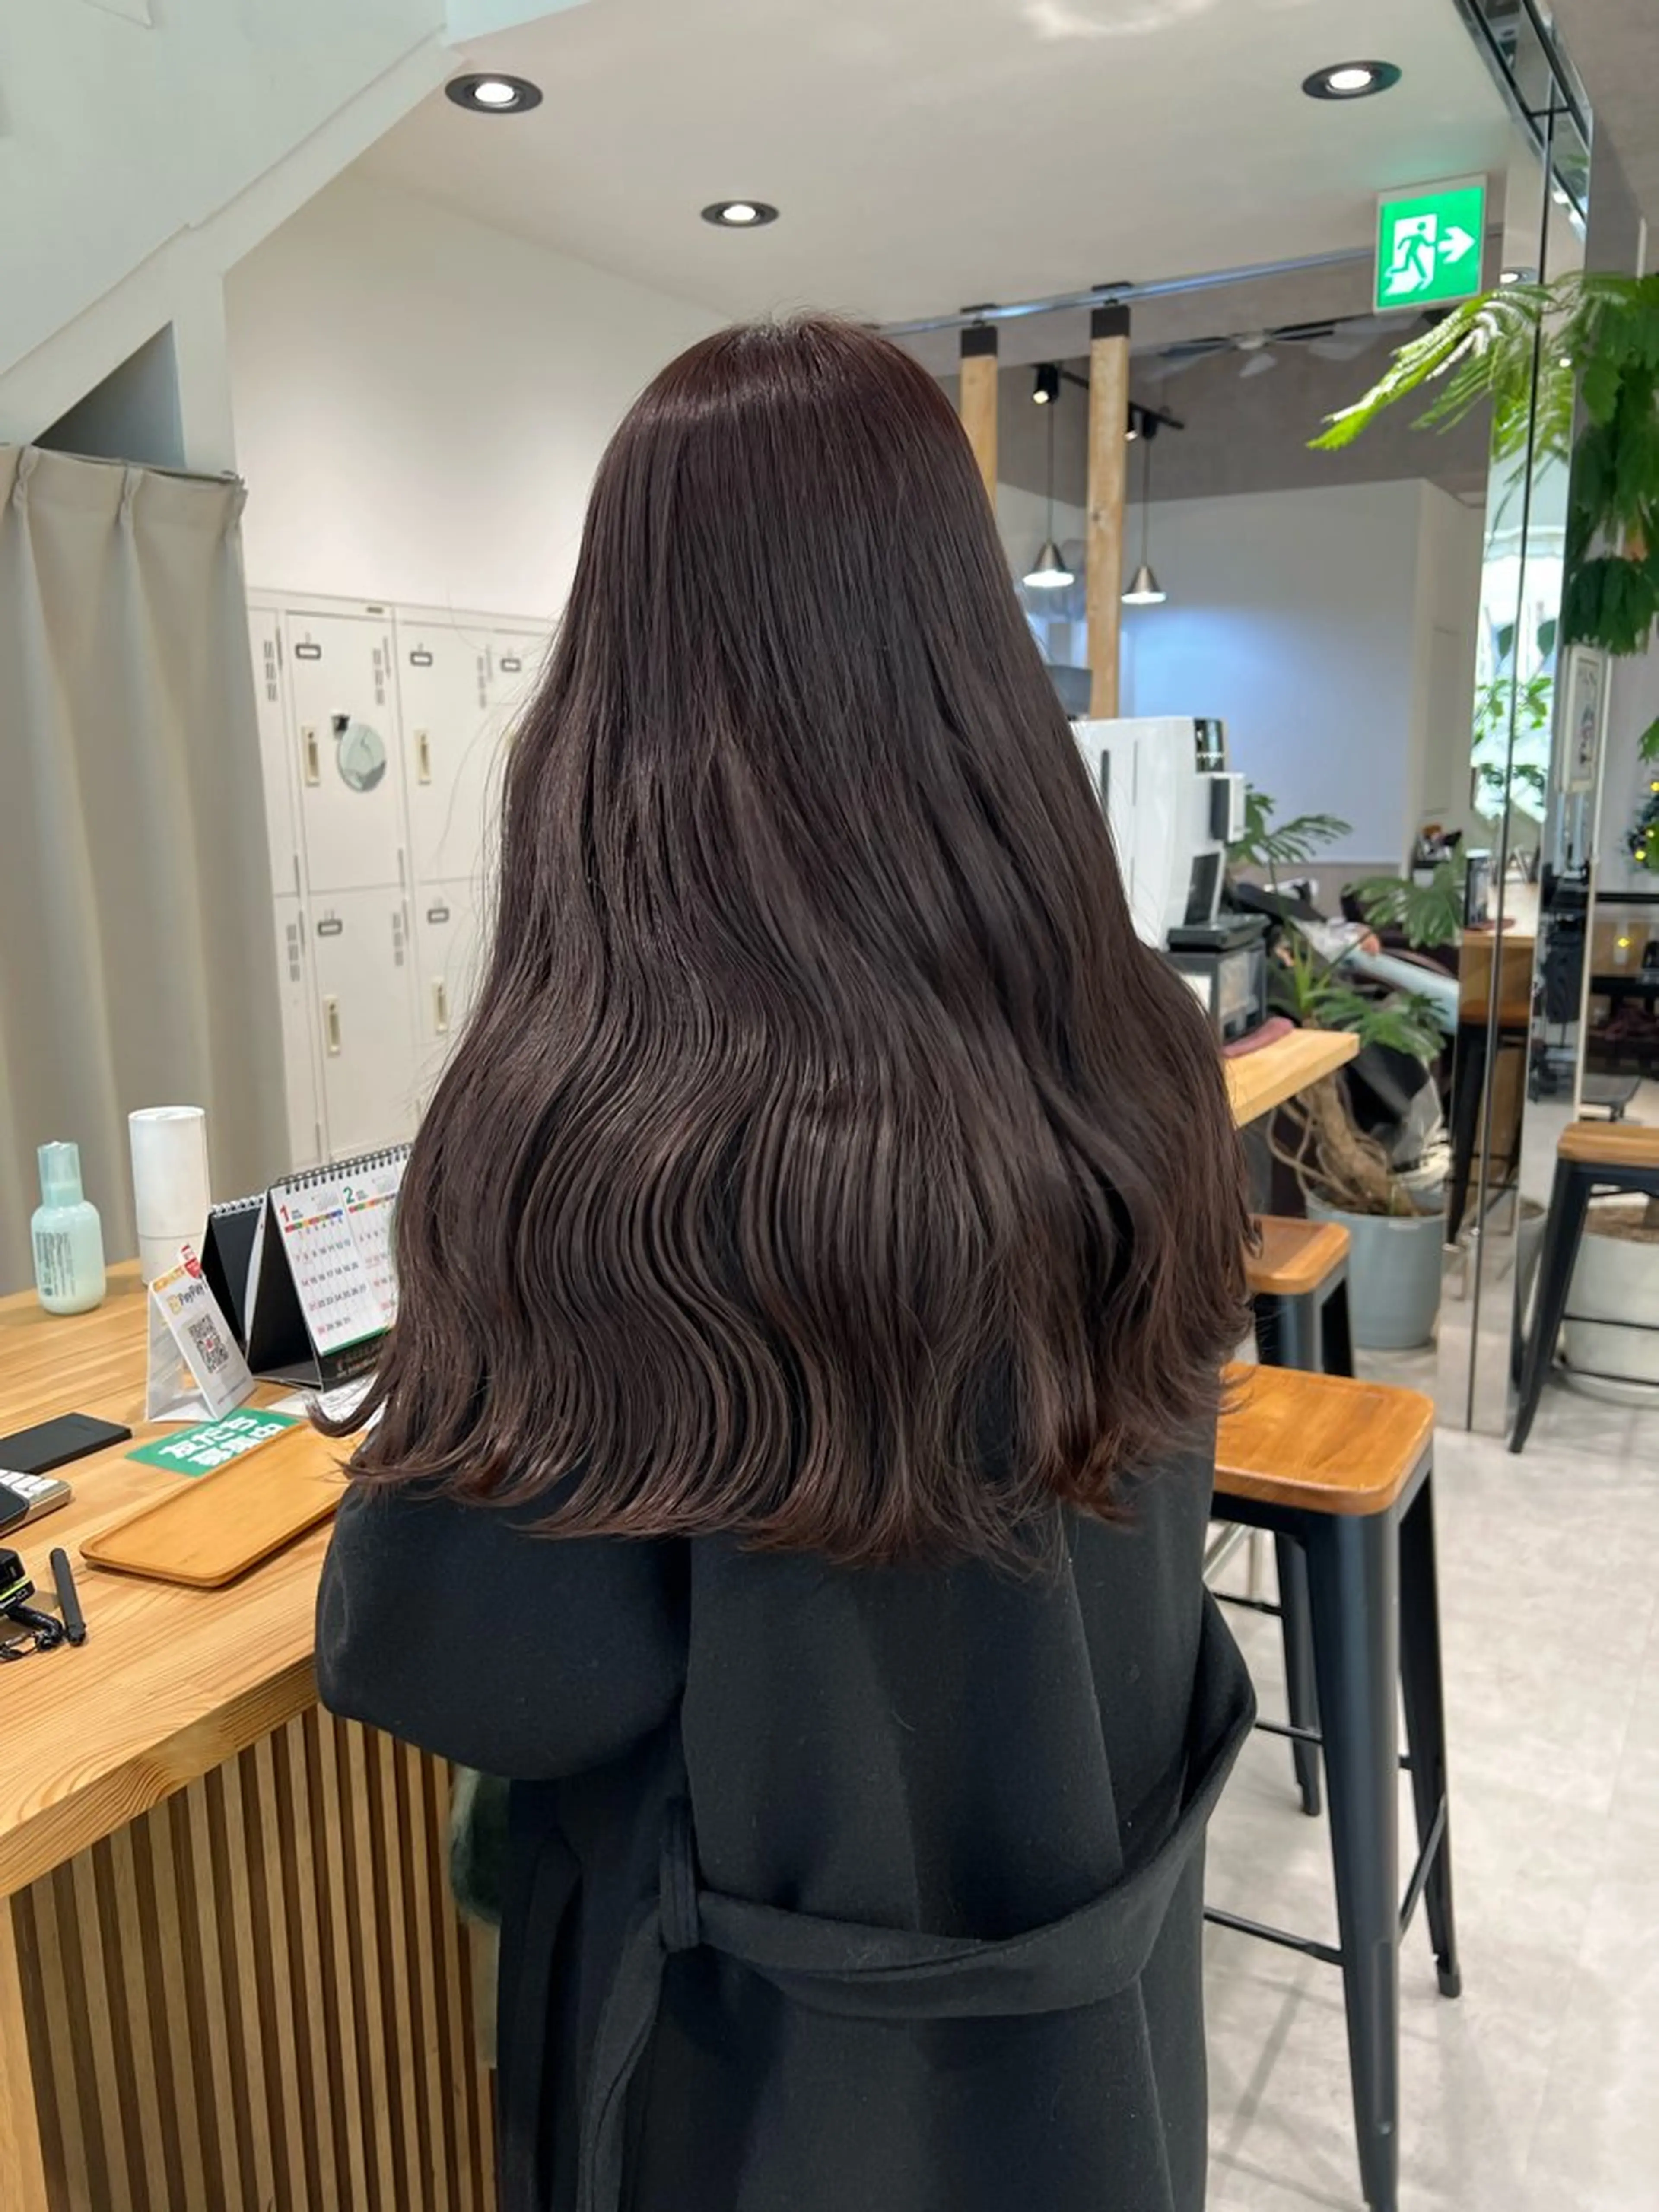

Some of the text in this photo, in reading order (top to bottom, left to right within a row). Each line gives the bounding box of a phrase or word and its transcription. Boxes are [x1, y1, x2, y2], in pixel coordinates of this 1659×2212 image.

[343, 1186, 354, 1203] 2
[280, 1205, 289, 1222] 1
[158, 1417, 258, 1459] 友だち
